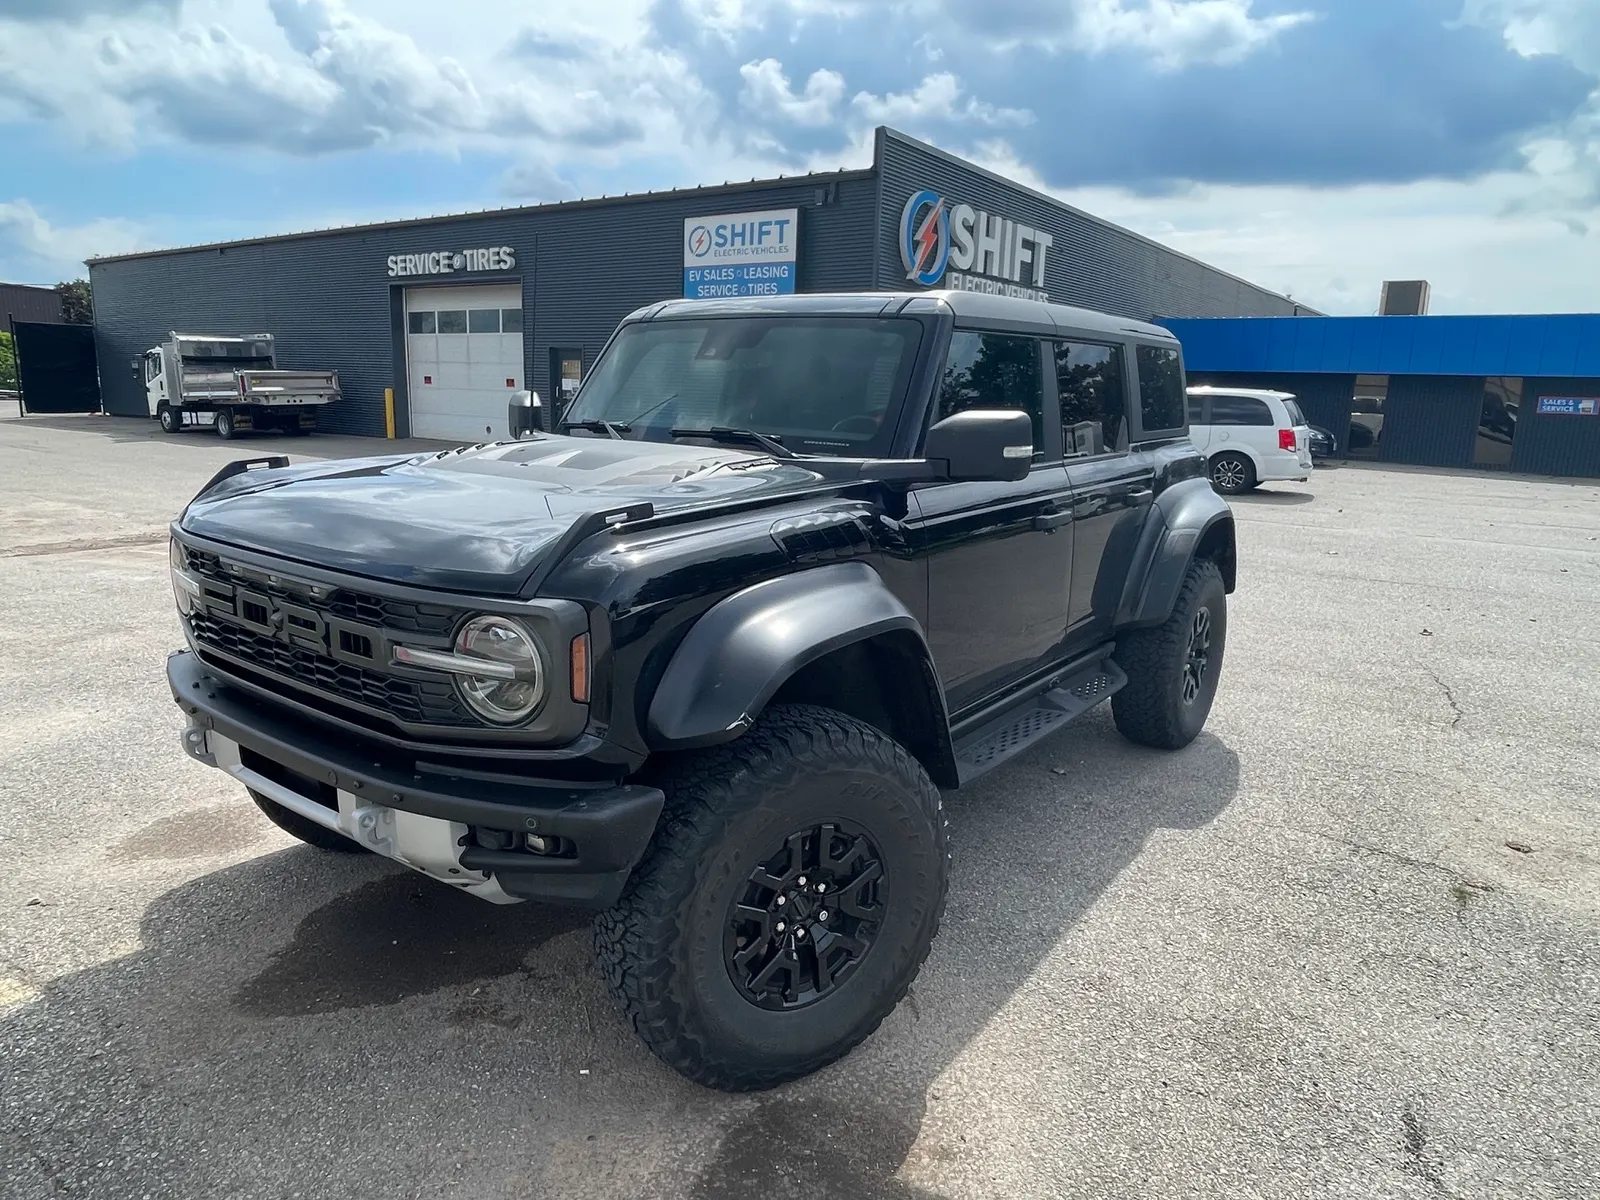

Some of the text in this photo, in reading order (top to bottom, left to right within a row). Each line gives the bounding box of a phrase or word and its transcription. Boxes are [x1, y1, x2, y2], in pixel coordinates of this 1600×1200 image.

[714, 219, 789, 247] SHIFT
[948, 204, 1053, 287] SHIFT
[387, 246, 515, 276] SERVICE TIRES
[714, 246, 789, 257] ELECTRIC VEHICLES
[689, 265, 788, 281] EV SALES LEASING
[697, 283, 777, 297] SERVICE TIRES
[199, 576, 386, 670] FORD
